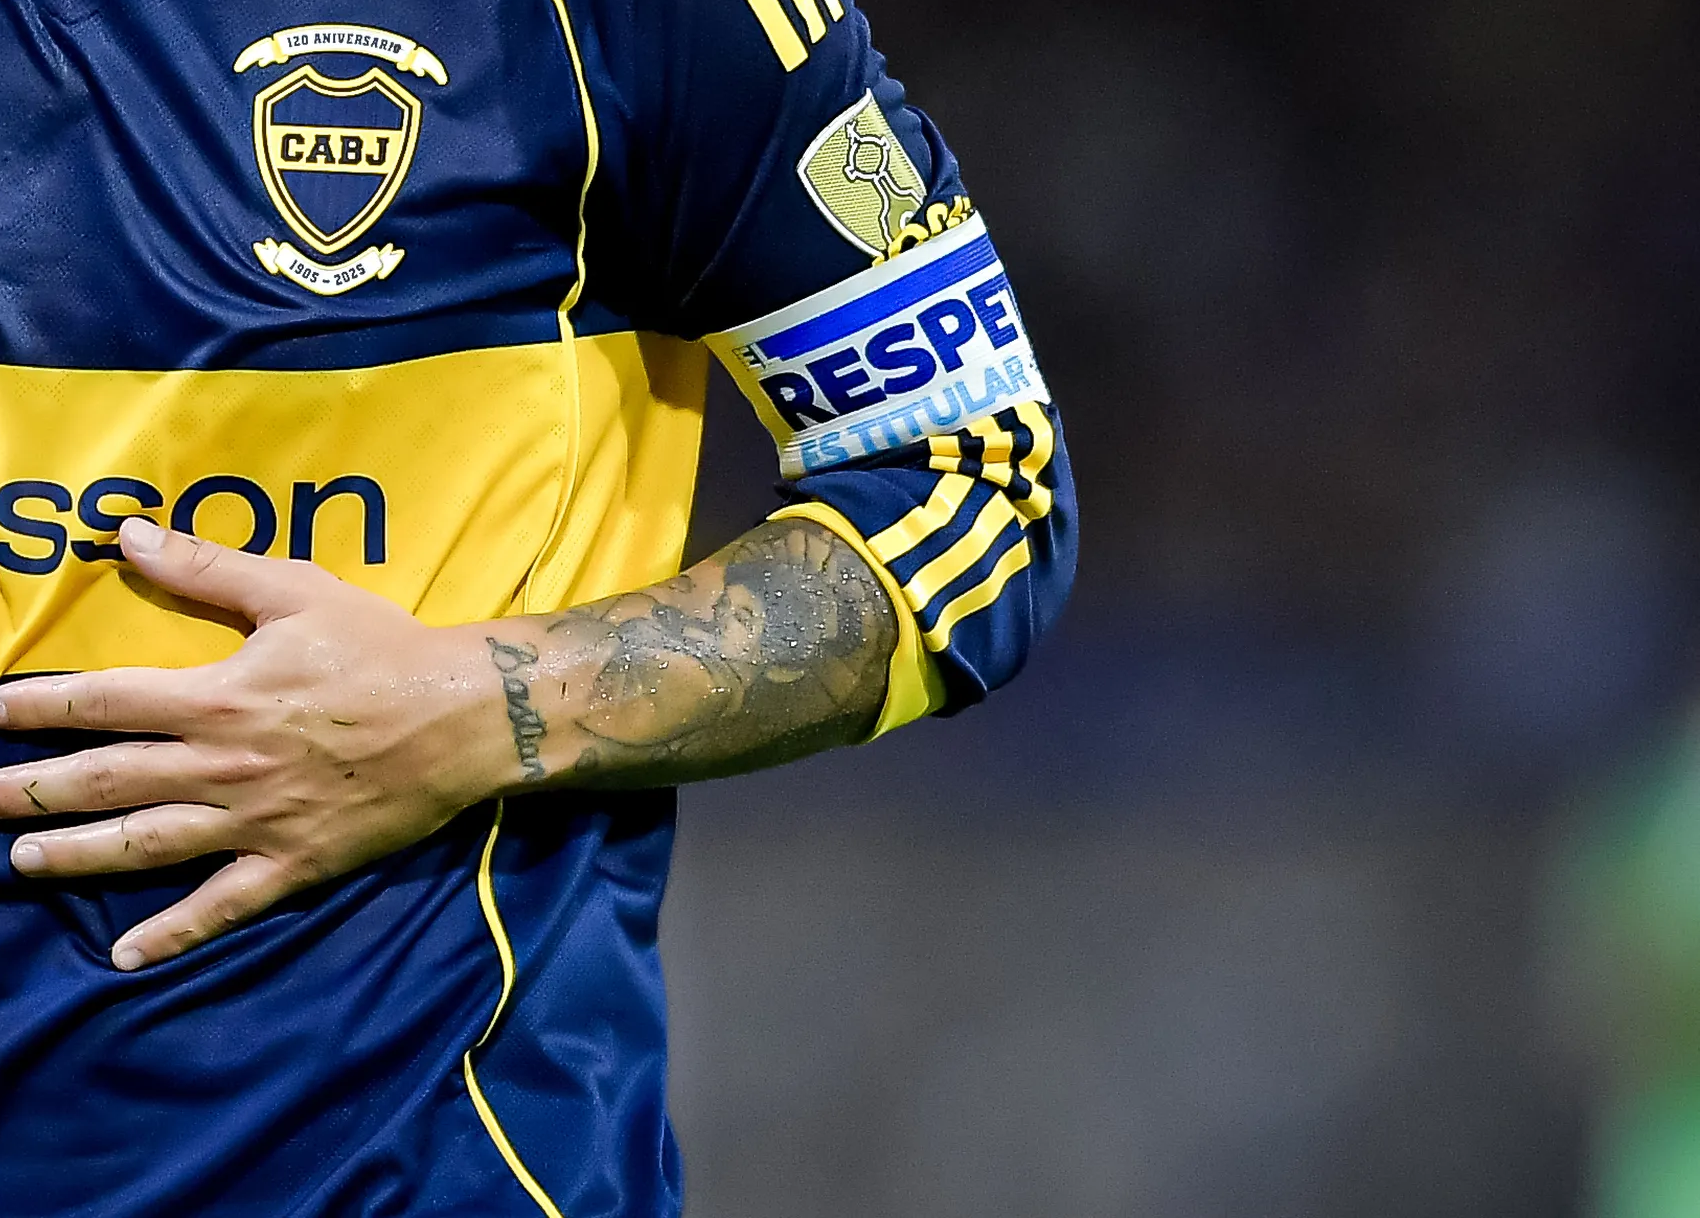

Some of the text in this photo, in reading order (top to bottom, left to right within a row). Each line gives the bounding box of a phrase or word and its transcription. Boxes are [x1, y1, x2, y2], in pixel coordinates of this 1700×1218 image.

[287, 32, 402, 54] 120 ANIVERSARIO
[280, 132, 390, 166] CABJ
[289, 259, 320, 283] 1905
[333, 263, 366, 286] 2025
[846, 355, 1031, 457] TITULAR
